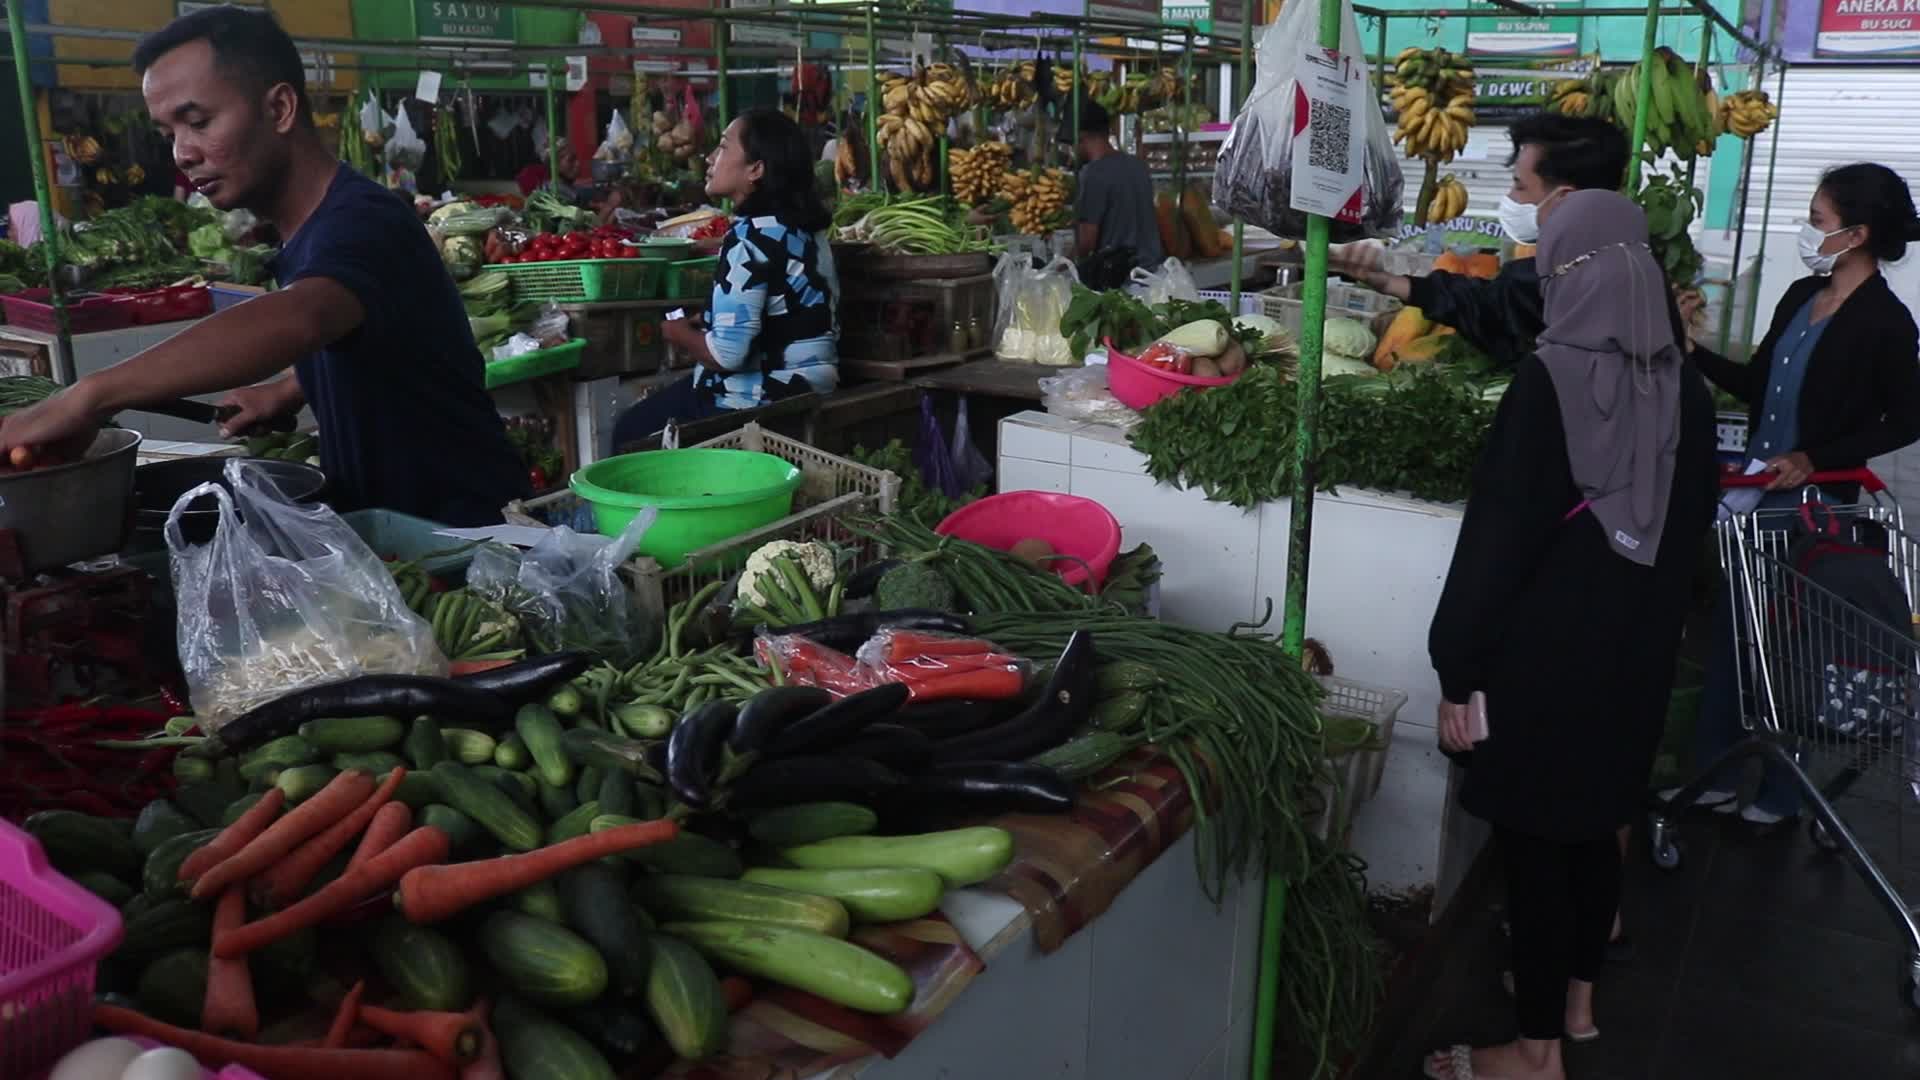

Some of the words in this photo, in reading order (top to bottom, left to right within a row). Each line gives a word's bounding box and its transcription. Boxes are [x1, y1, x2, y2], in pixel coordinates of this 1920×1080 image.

[1837, 0, 1898, 12] ANEKA
[1860, 18, 1879, 30] BU
[1880, 18, 1912, 30] SUCI
